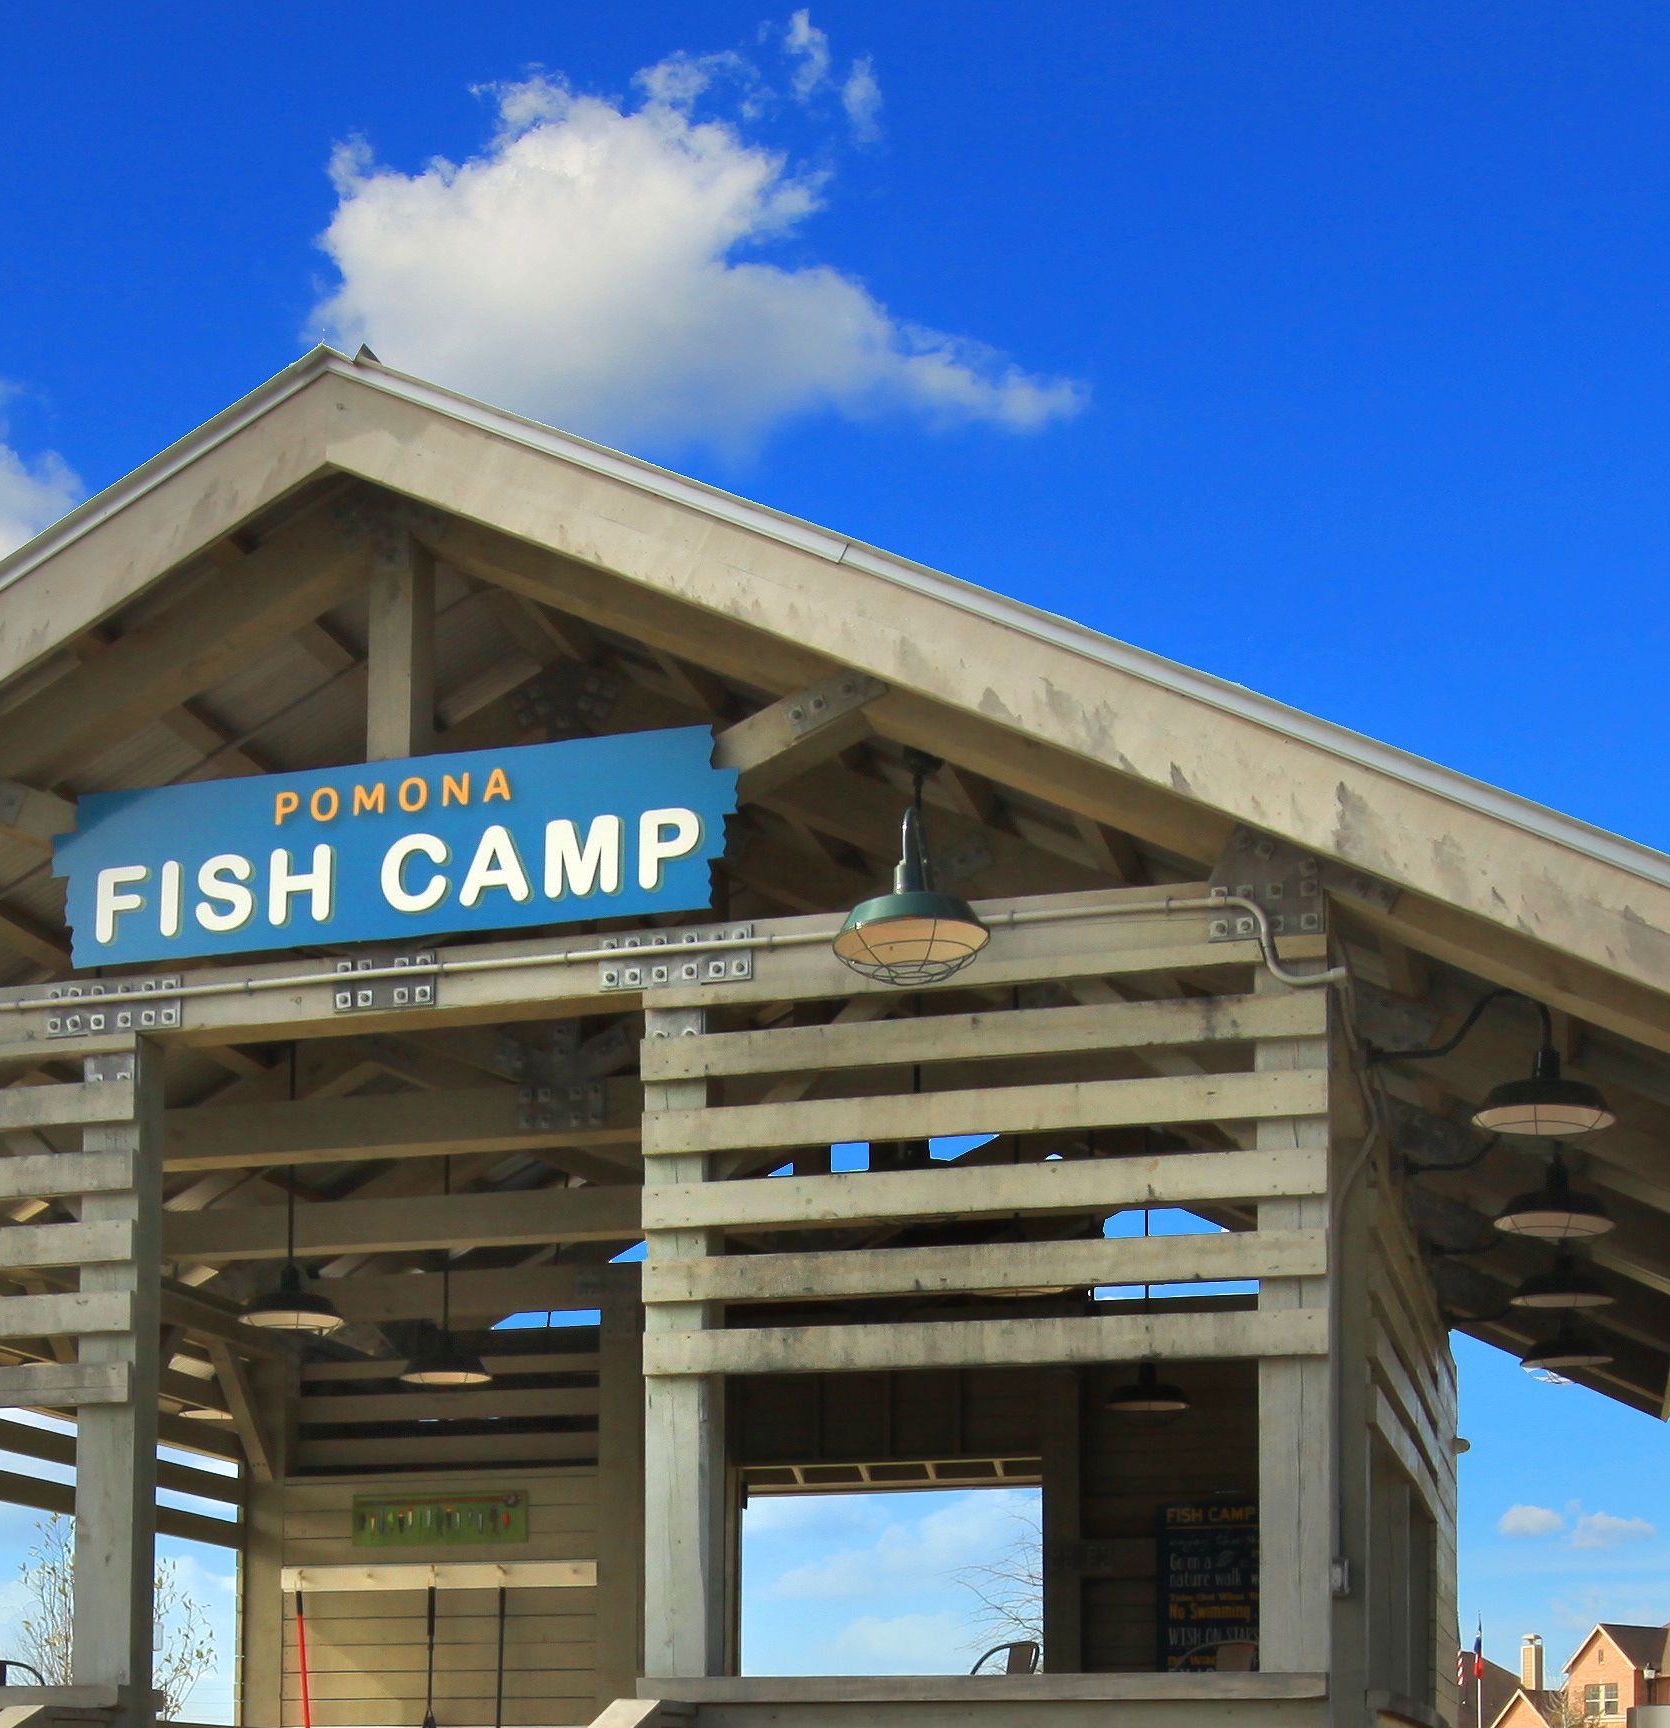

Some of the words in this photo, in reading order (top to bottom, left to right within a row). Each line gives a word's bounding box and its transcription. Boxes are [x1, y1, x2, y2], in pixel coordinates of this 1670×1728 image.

[274, 767, 512, 826] POMONA
[94, 843, 334, 945] FISH
[380, 807, 700, 913] CAMP
[1166, 1507, 1203, 1523] FISH
[1208, 1506, 1256, 1521] CAMP
[1187, 1557, 1200, 1570] on
[1203, 1556, 1212, 1570] a
[1169, 1571, 1211, 1587] nature
[1214, 1568, 1242, 1586] walk
[1169, 1603, 1185, 1620] No
[1168, 1627, 1201, 1646] WISH
